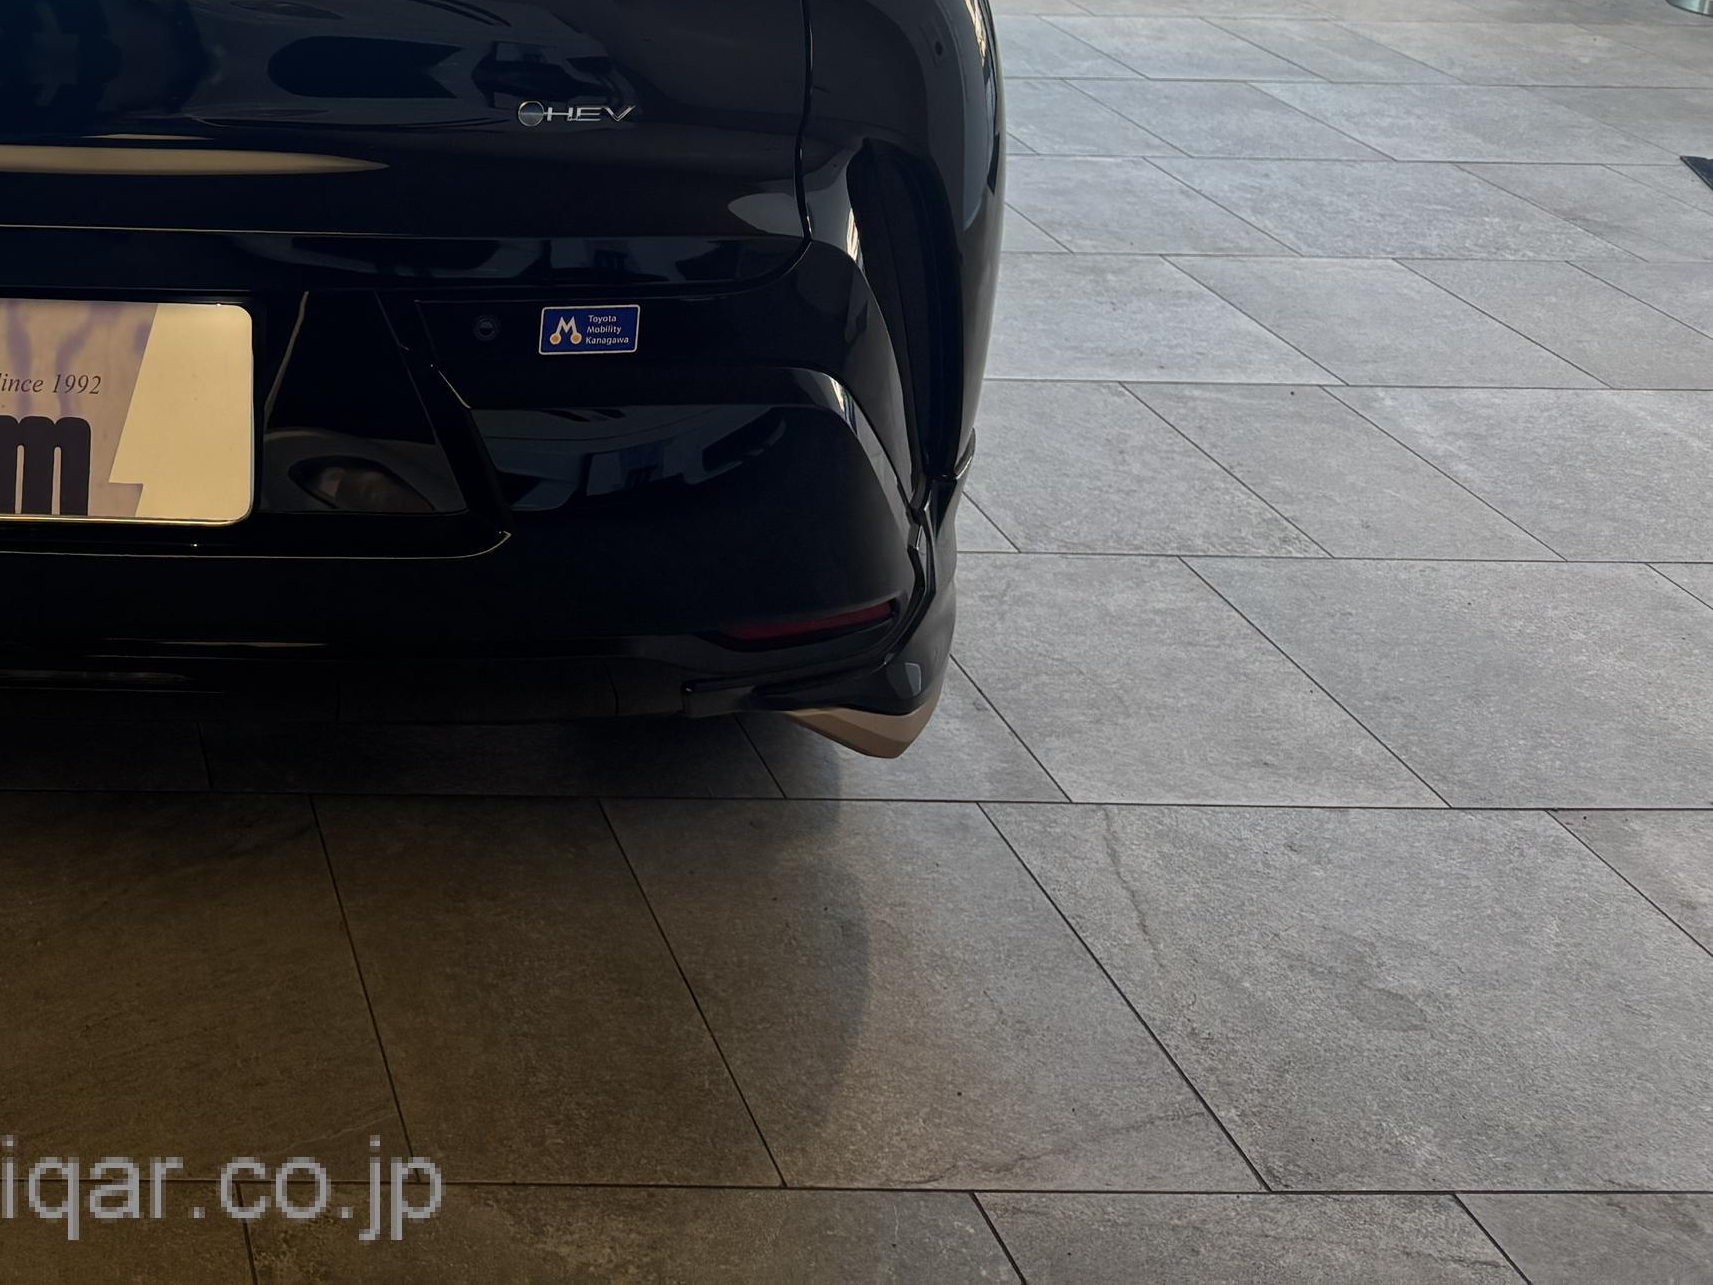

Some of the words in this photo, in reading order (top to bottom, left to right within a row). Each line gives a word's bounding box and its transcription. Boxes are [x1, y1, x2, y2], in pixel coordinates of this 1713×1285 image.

[544, 106, 636, 122] HEV
[589, 315, 617, 324] Toyota
[586, 325, 622, 334] Mobility
[585, 336, 629, 345] Kanagawa
[51, 374, 102, 395] 1992
